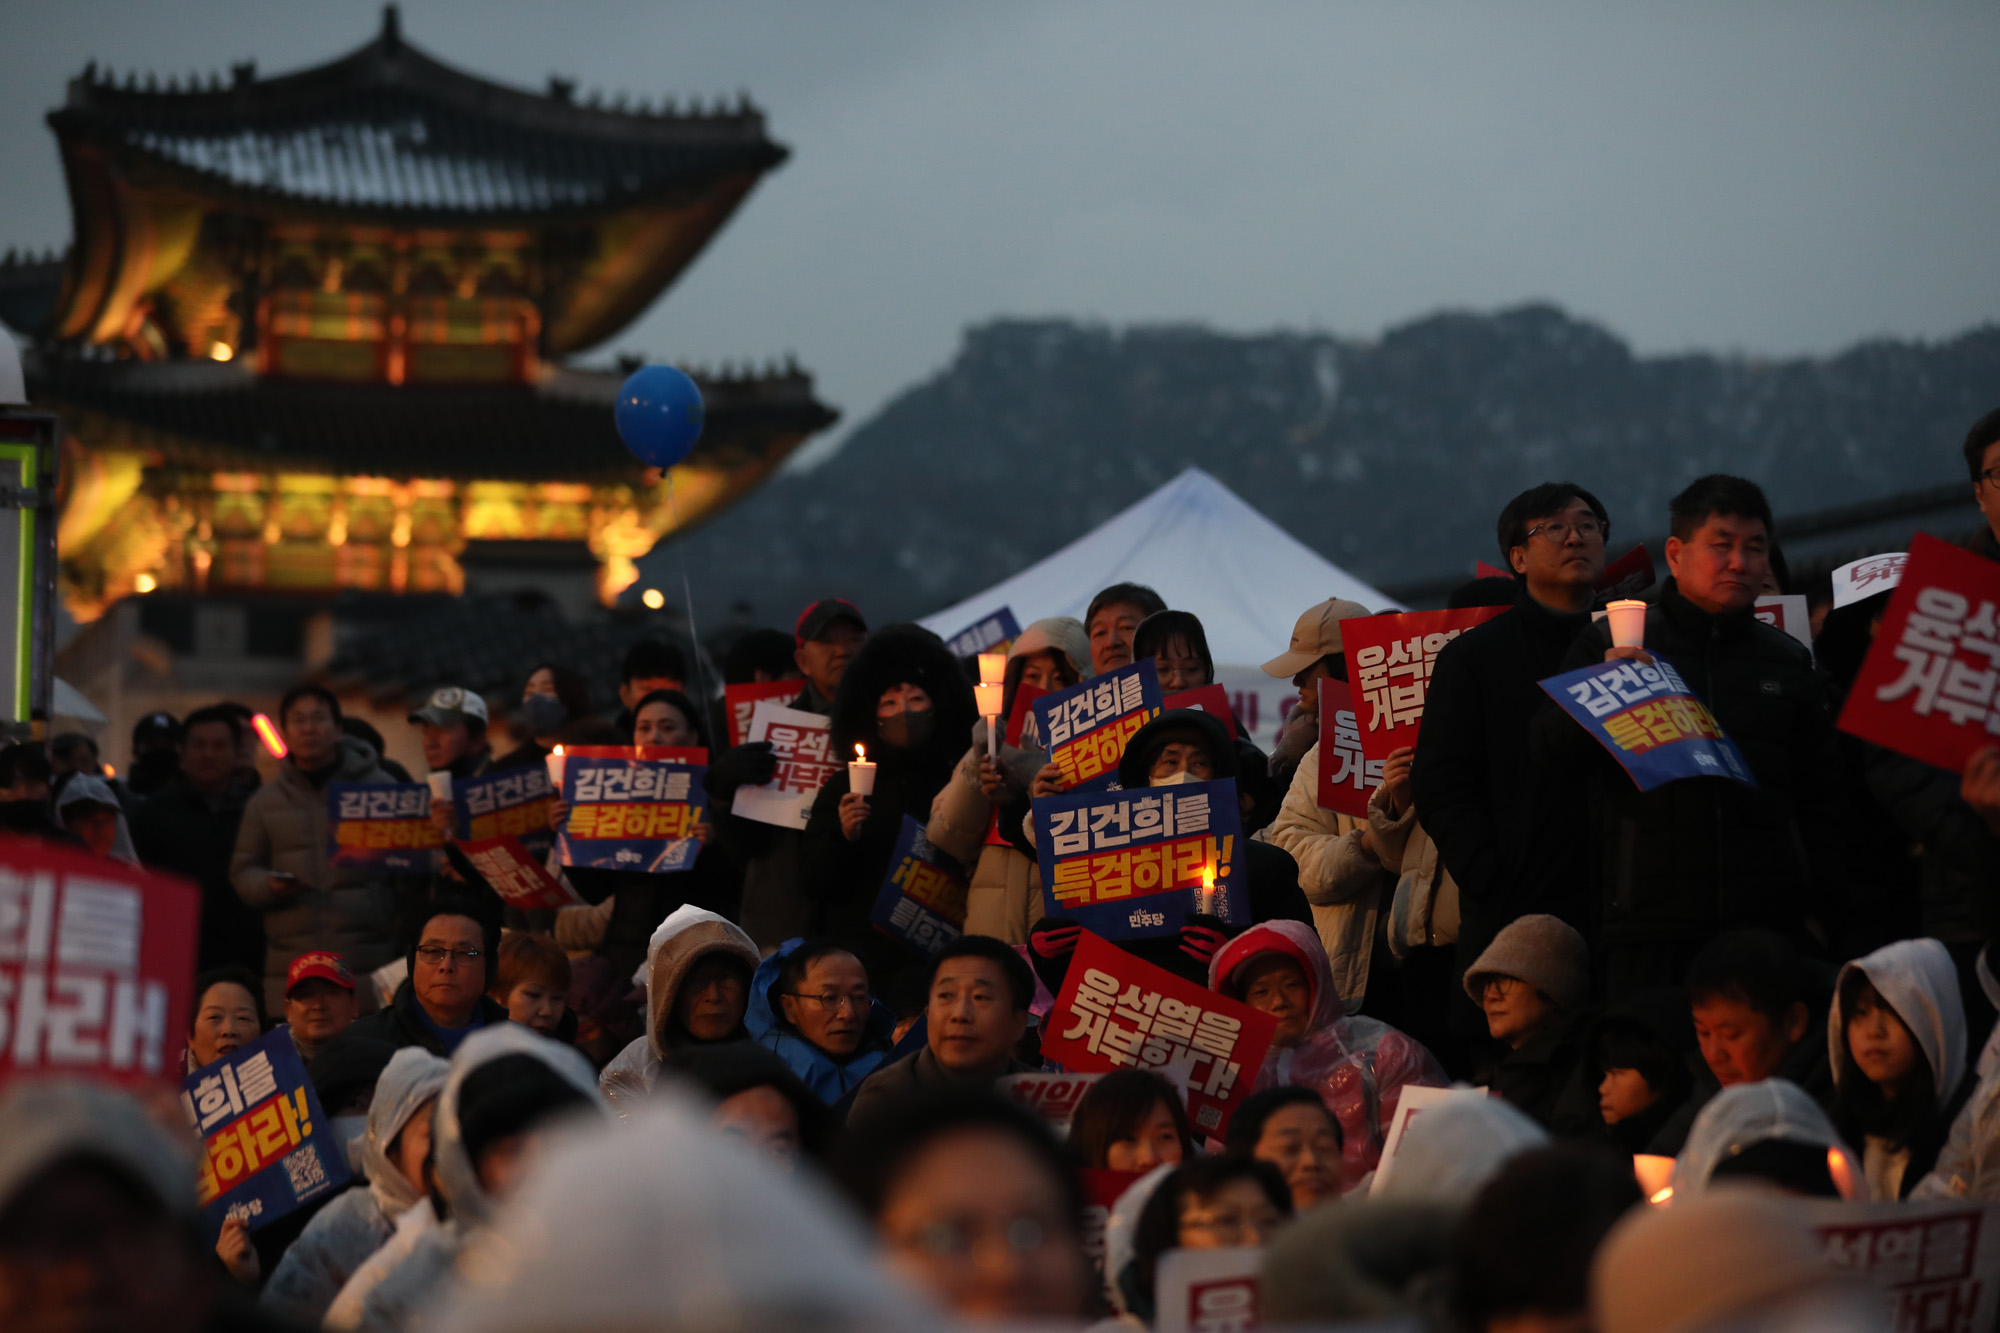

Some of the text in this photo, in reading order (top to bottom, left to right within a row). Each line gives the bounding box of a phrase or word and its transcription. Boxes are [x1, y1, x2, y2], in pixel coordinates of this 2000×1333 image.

[1047, 672, 1144, 746] 김건희를
[1363, 679, 1430, 732] 거부
[1567, 655, 1692, 718] 김건희를
[1875, 643, 2000, 737] 거부
[769, 726, 841, 763] 윤석
[1601, 698, 1724, 751] 특검하라!
[339, 788, 429, 818] 김건희
[466, 768, 553, 816] 김건희
[574, 767, 692, 801] 김건희를
[567, 804, 703, 838] 특검하라!
[1049, 792, 1212, 856] 김건희를
[1052, 834, 1235, 903] 특검하라!
[1129, 913, 1164, 928] 민주당
[1069, 967, 1242, 1059] 윤석열을
[1062, 1003, 1242, 1100] 거부한다!
